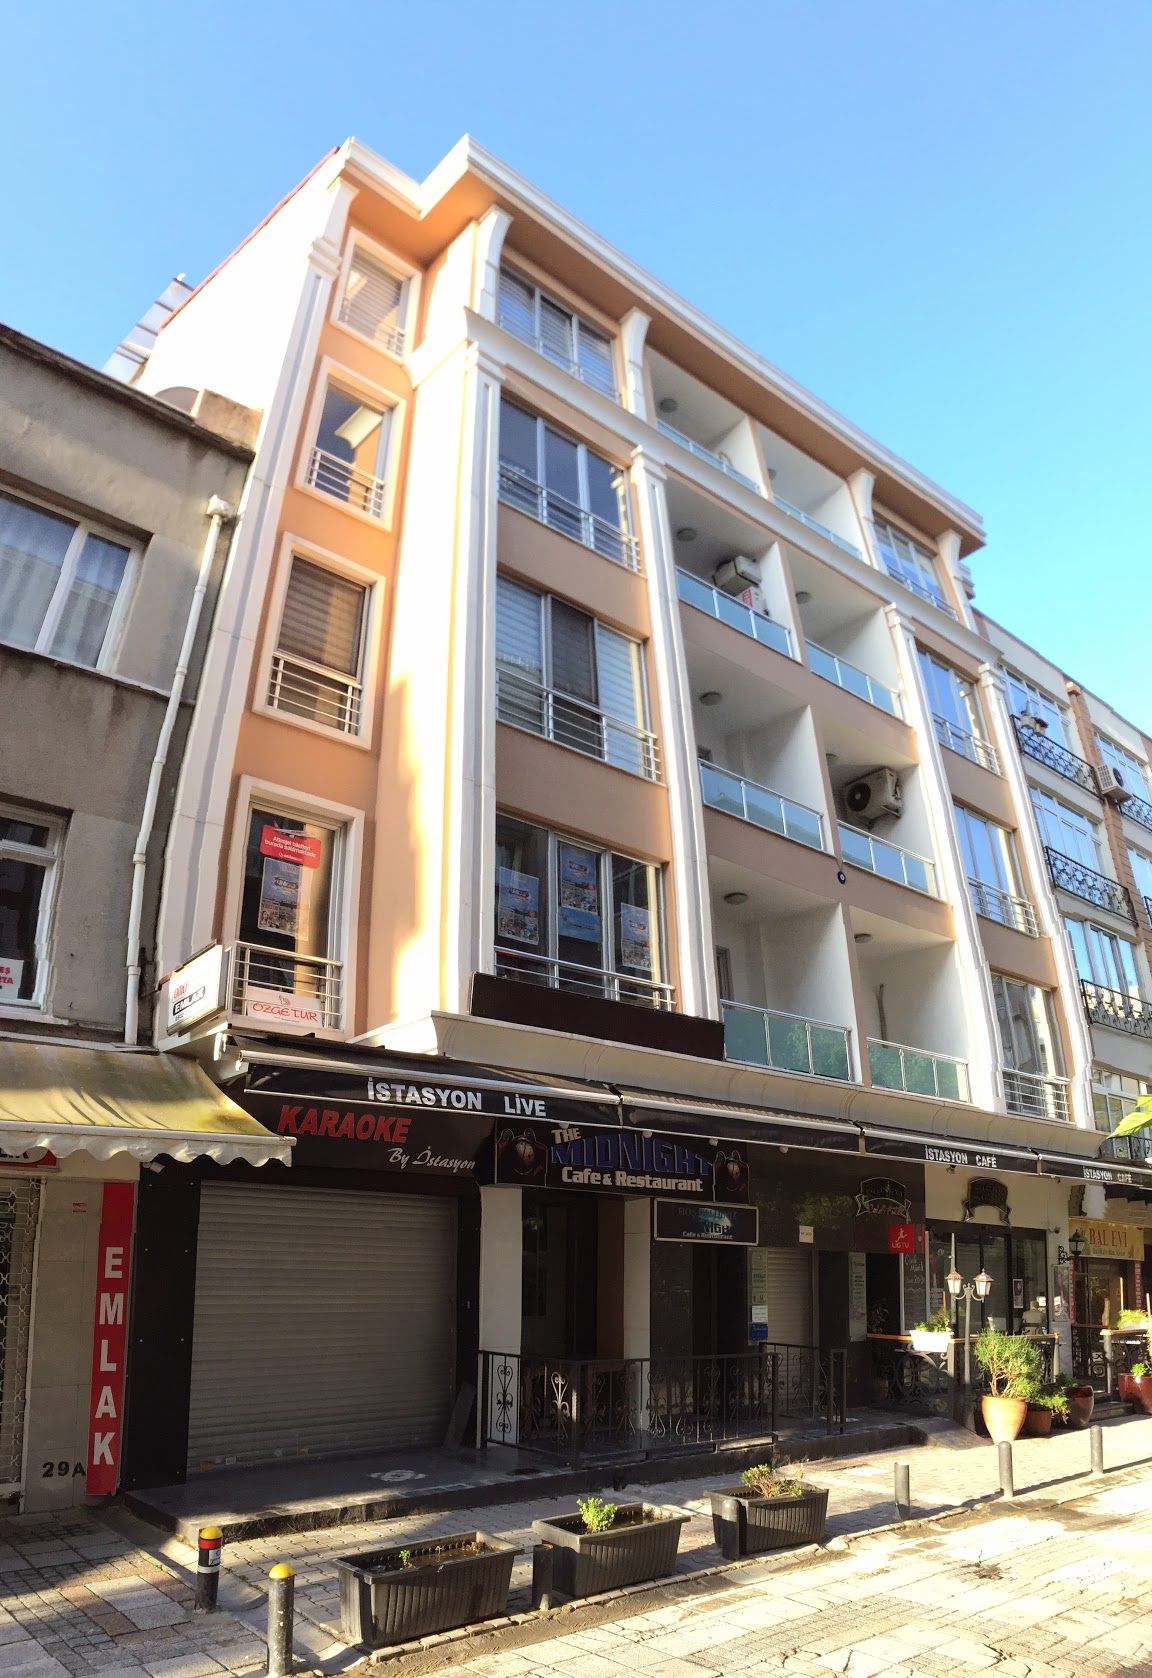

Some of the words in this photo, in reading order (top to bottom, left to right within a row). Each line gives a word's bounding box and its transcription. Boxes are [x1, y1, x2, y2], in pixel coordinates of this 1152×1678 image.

[367, 1077, 482, 1110] İSTASYON
[504, 1094, 547, 1117] LİVE
[277, 1105, 412, 1144] KARAOKE
[551, 1128, 582, 1144] THE
[387, 1148, 410, 1169] By
[412, 1146, 476, 1174] İstasyon
[551, 1133, 713, 1176] MIDNIGHT
[925, 1145, 969, 1165] İSTASYON
[561, 1166, 601, 1185] Cafe
[602, 1173, 613, 1186] &
[615, 1170, 703, 1192] Restaurant
[1083, 1166, 1113, 1181] İSTASYON
[1089, 1228, 1108, 1246] BAL
[93, 1246, 124, 1466] EMLAK
[42, 1461, 86, 1479] 29A
